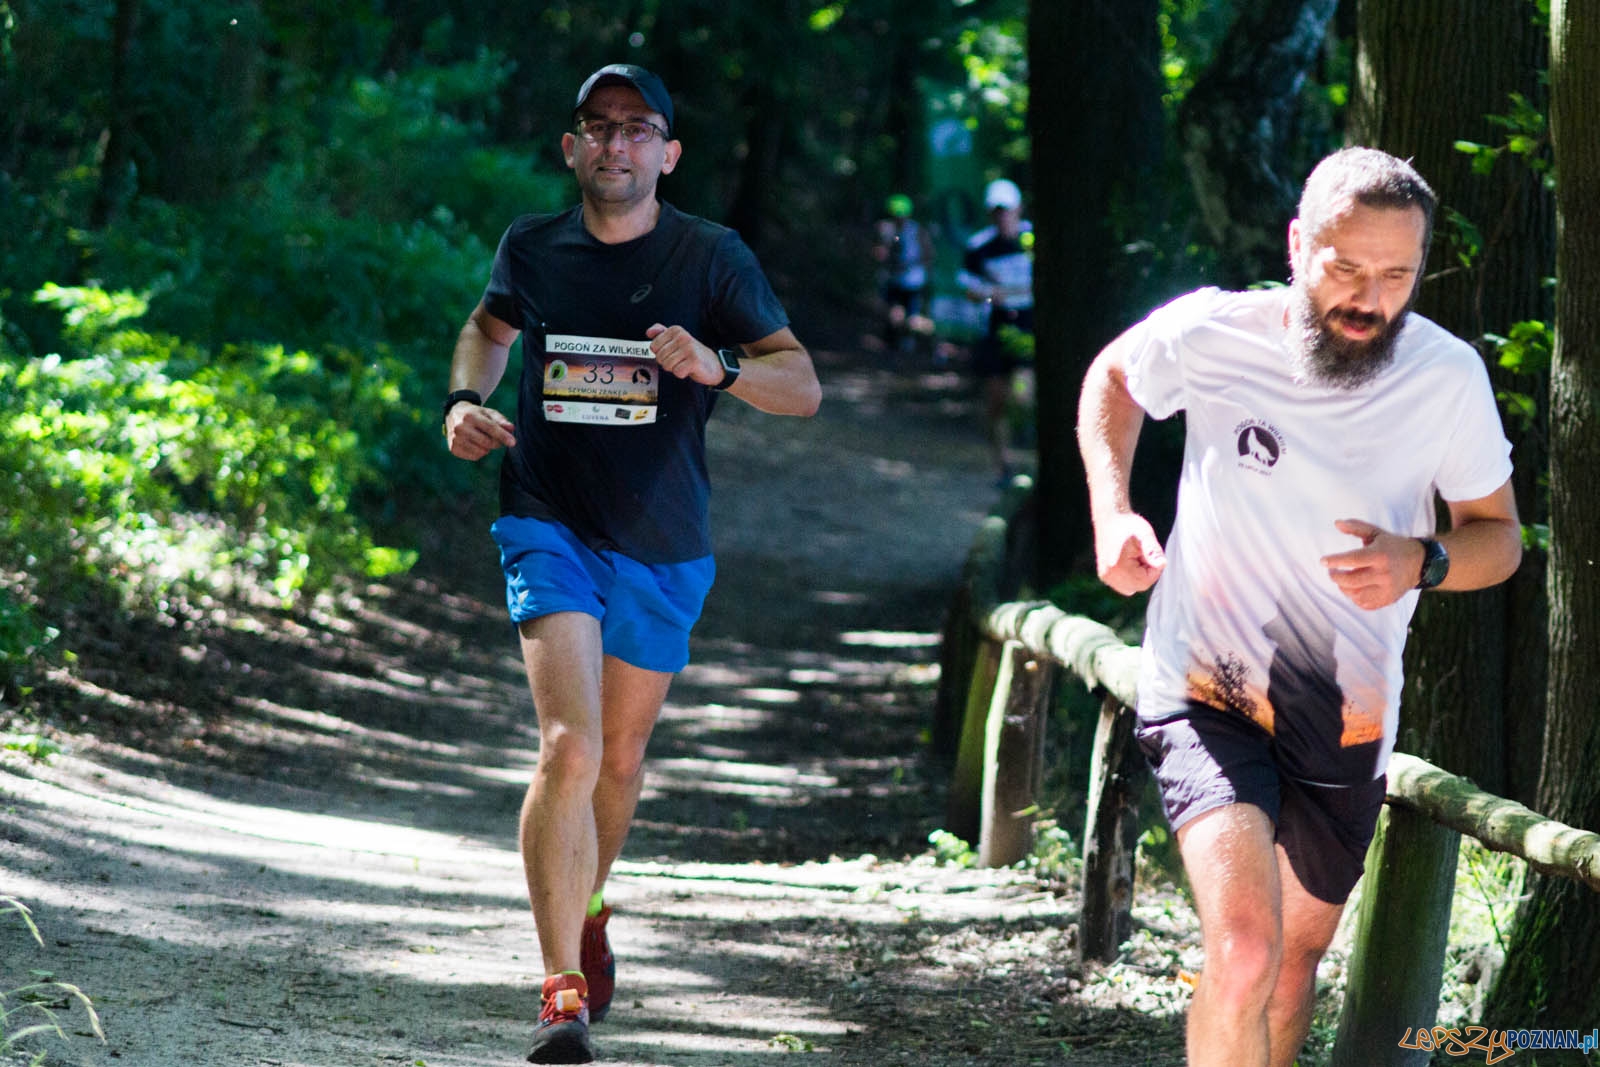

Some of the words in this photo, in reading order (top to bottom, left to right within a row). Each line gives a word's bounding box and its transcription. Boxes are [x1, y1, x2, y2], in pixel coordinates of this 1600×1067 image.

[593, 344, 606, 353] ZA
[609, 345, 650, 356] WILKIEM
[583, 361, 614, 384] 33
[567, 386, 597, 394] SZYMON
